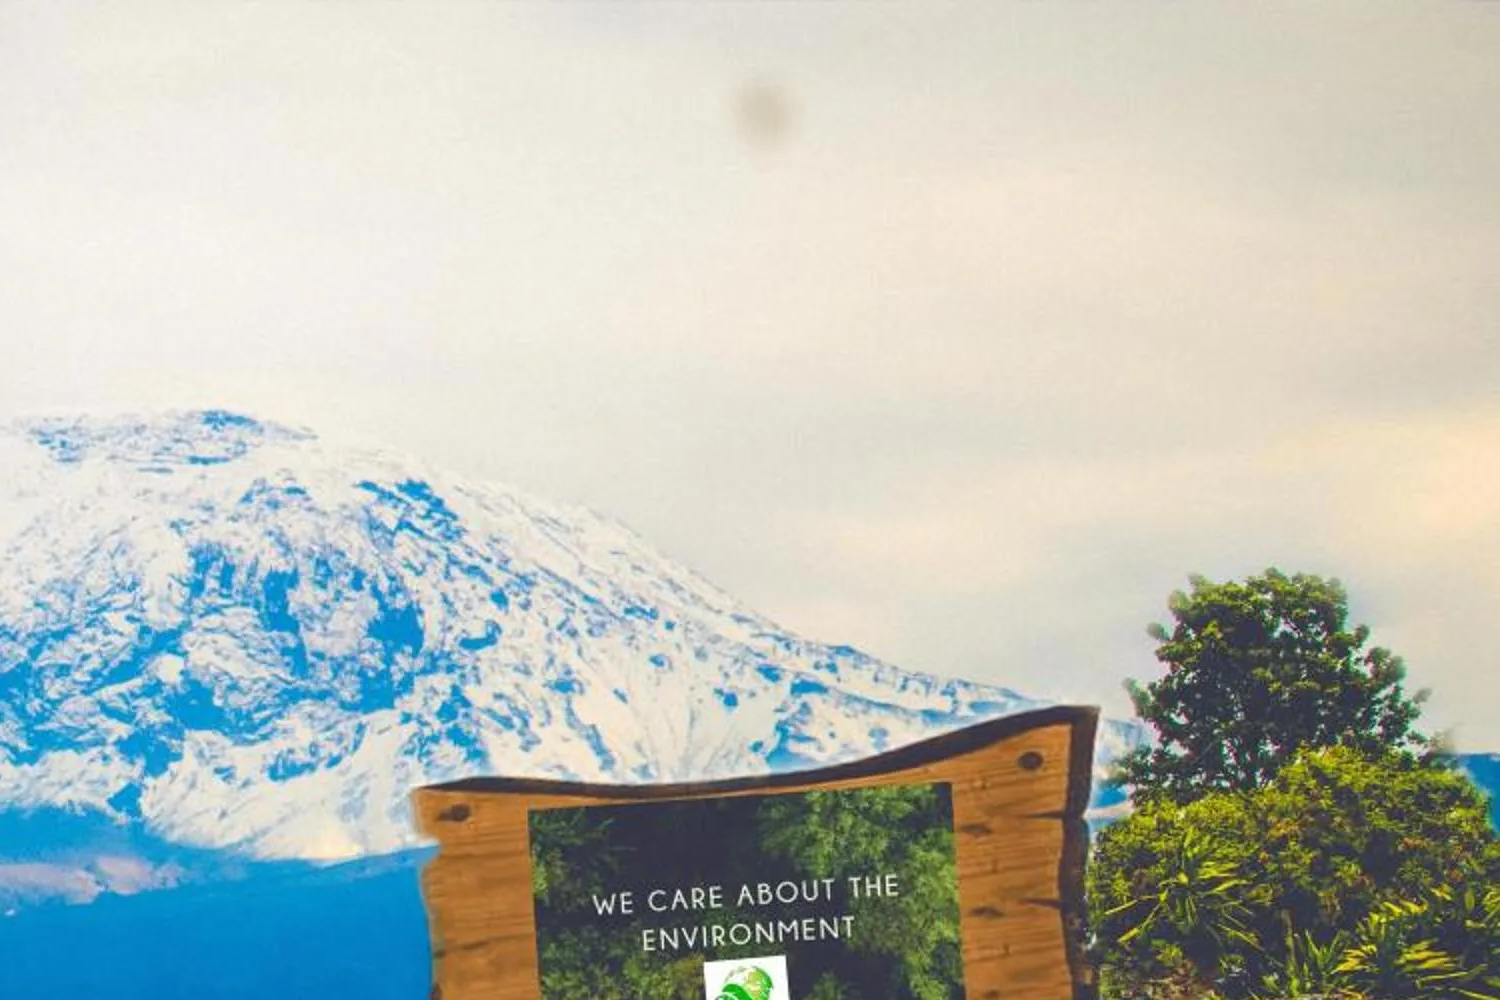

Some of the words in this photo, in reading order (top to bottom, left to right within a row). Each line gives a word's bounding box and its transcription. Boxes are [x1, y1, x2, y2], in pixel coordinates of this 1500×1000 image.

[592, 891, 634, 916] WE
[648, 885, 723, 912] CARE
[736, 878, 835, 907] ABOUT
[848, 873, 900, 899] THE
[642, 915, 856, 952] ENVIRONMENT
